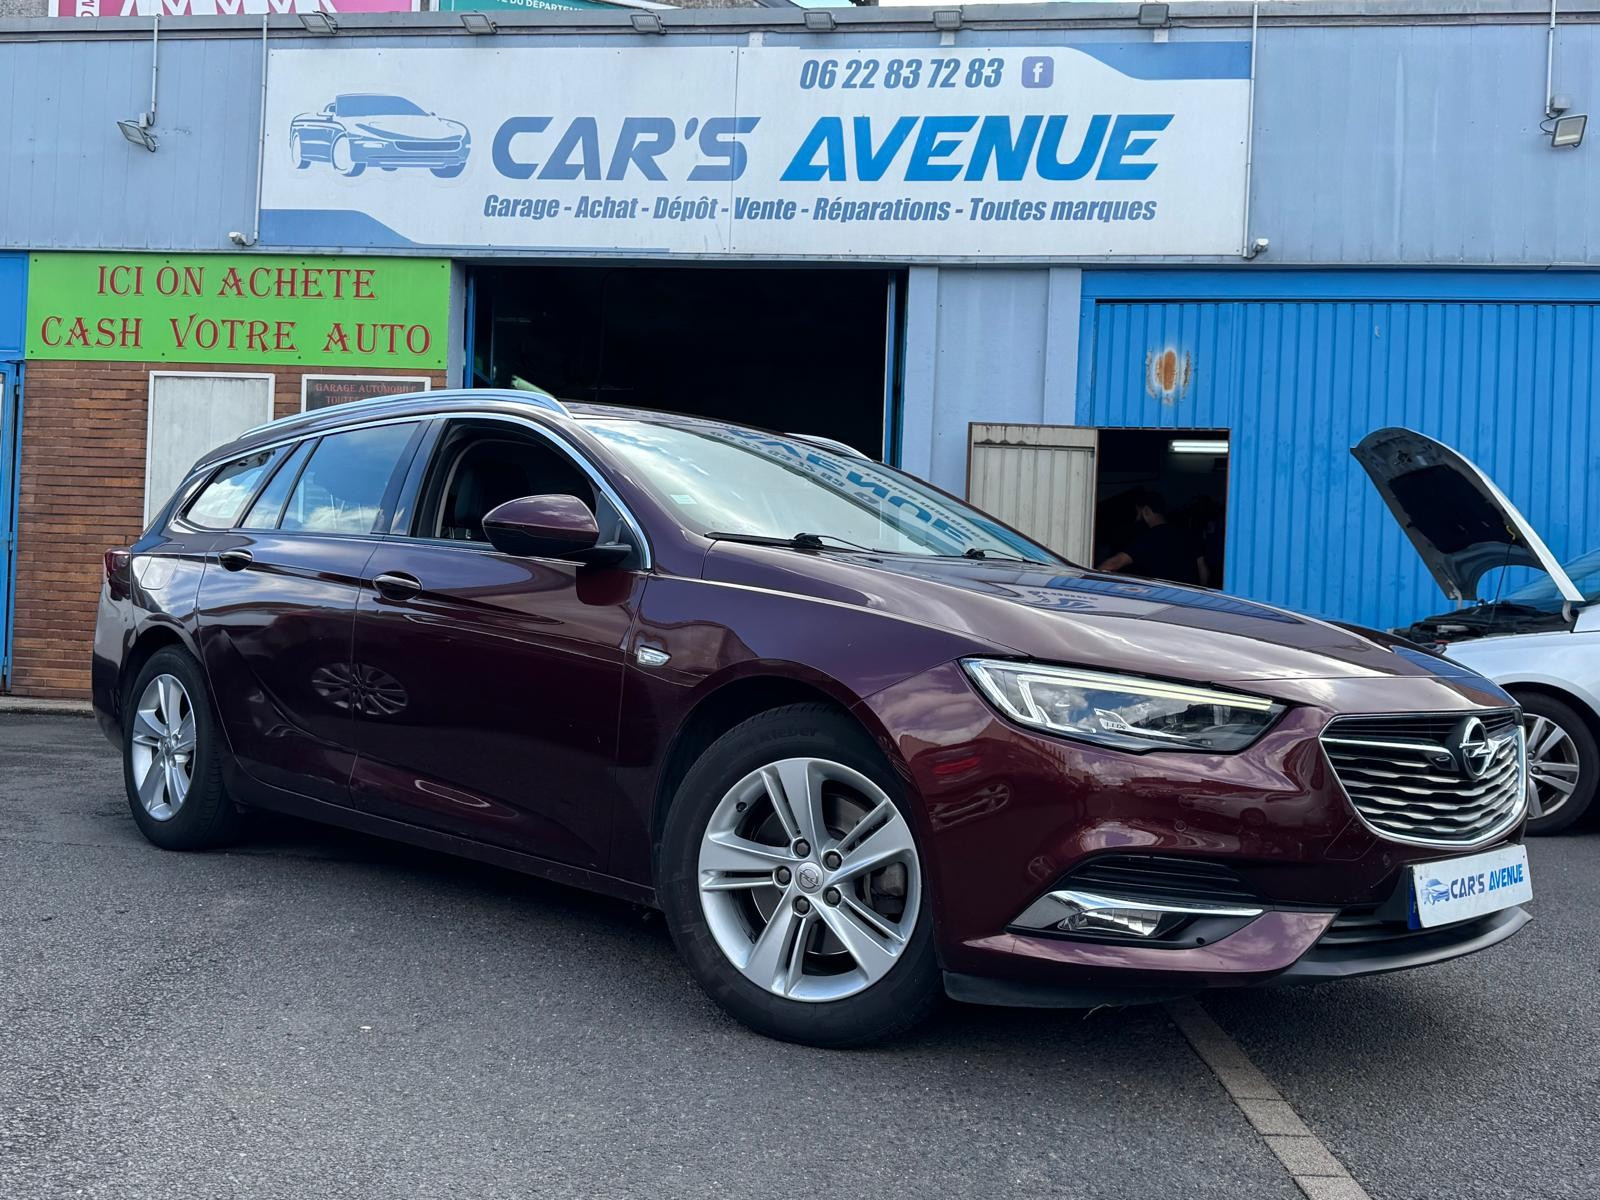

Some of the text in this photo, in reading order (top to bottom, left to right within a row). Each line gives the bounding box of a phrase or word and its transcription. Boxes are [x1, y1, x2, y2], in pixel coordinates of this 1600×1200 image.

[800, 57, 1004, 90] 06 22 83 72 83
[492, 113, 1175, 182] CAR'S AVENUE
[484, 194, 560, 220] Garage
[574, 196, 638, 219] Achat
[653, 195, 718, 222] Dépôt
[734, 197, 797, 220] Vente
[813, 196, 951, 223] Réparations
[970, 197, 1047, 221] Toutes
[1050, 200, 1157, 223] marques
[97, 265, 377, 299] ICI ON ACHETE
[40, 313, 432, 355] CASH VOTRE AUTO
[315, 383, 357, 393] GARAGE
[1450, 863, 1524, 899] CAR'S AVENUE
